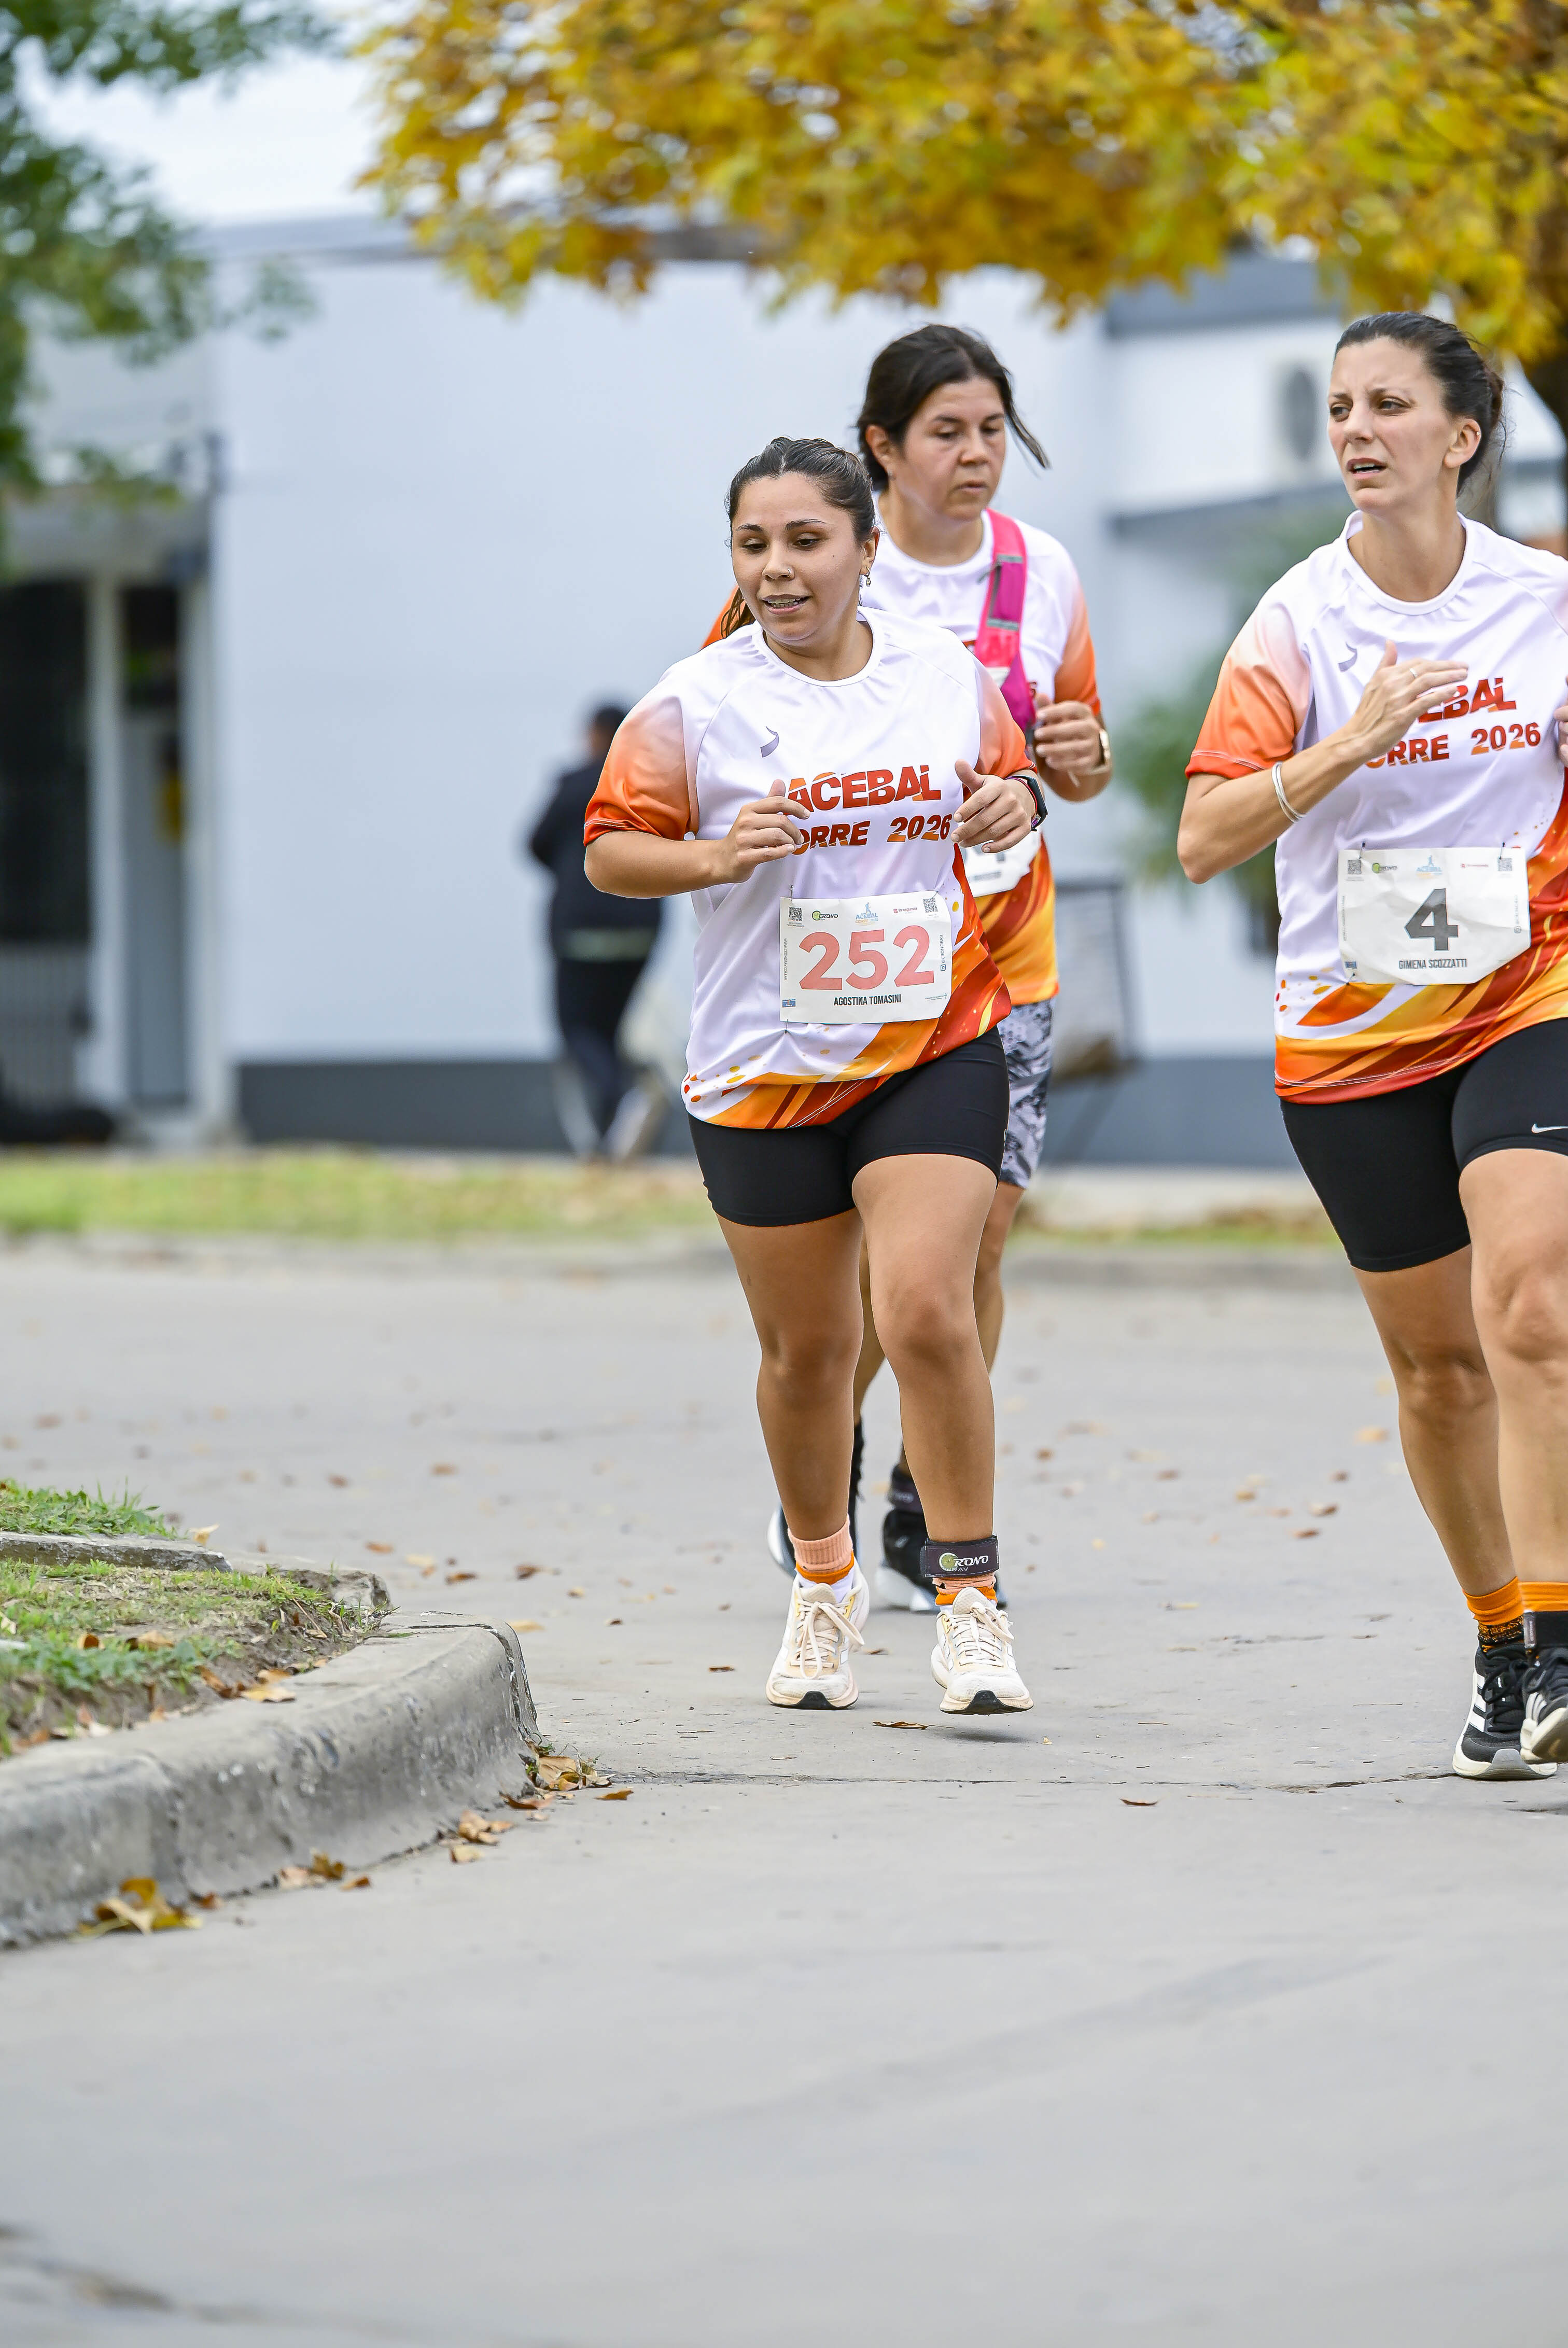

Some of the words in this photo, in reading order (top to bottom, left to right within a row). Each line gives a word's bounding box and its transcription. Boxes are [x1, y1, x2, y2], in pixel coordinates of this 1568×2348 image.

[1418, 677, 1516, 723] BAL
[1366, 734, 1449, 768] RRE
[1471, 722, 1541, 755] 2026
[783, 765, 941, 815] ACEBAL
[791, 821, 871, 855] ORRE
[887, 814, 952, 842] 2026
[1404, 888, 1458, 951] 4
[799, 925, 934, 990] 252
[1399, 960, 1427, 969] GIMENA
[1429, 959, 1467, 968] SCOZZATTI
[834, 997, 867, 1006] AGOSTINA
[869, 994, 901, 1005] TOMASINI
